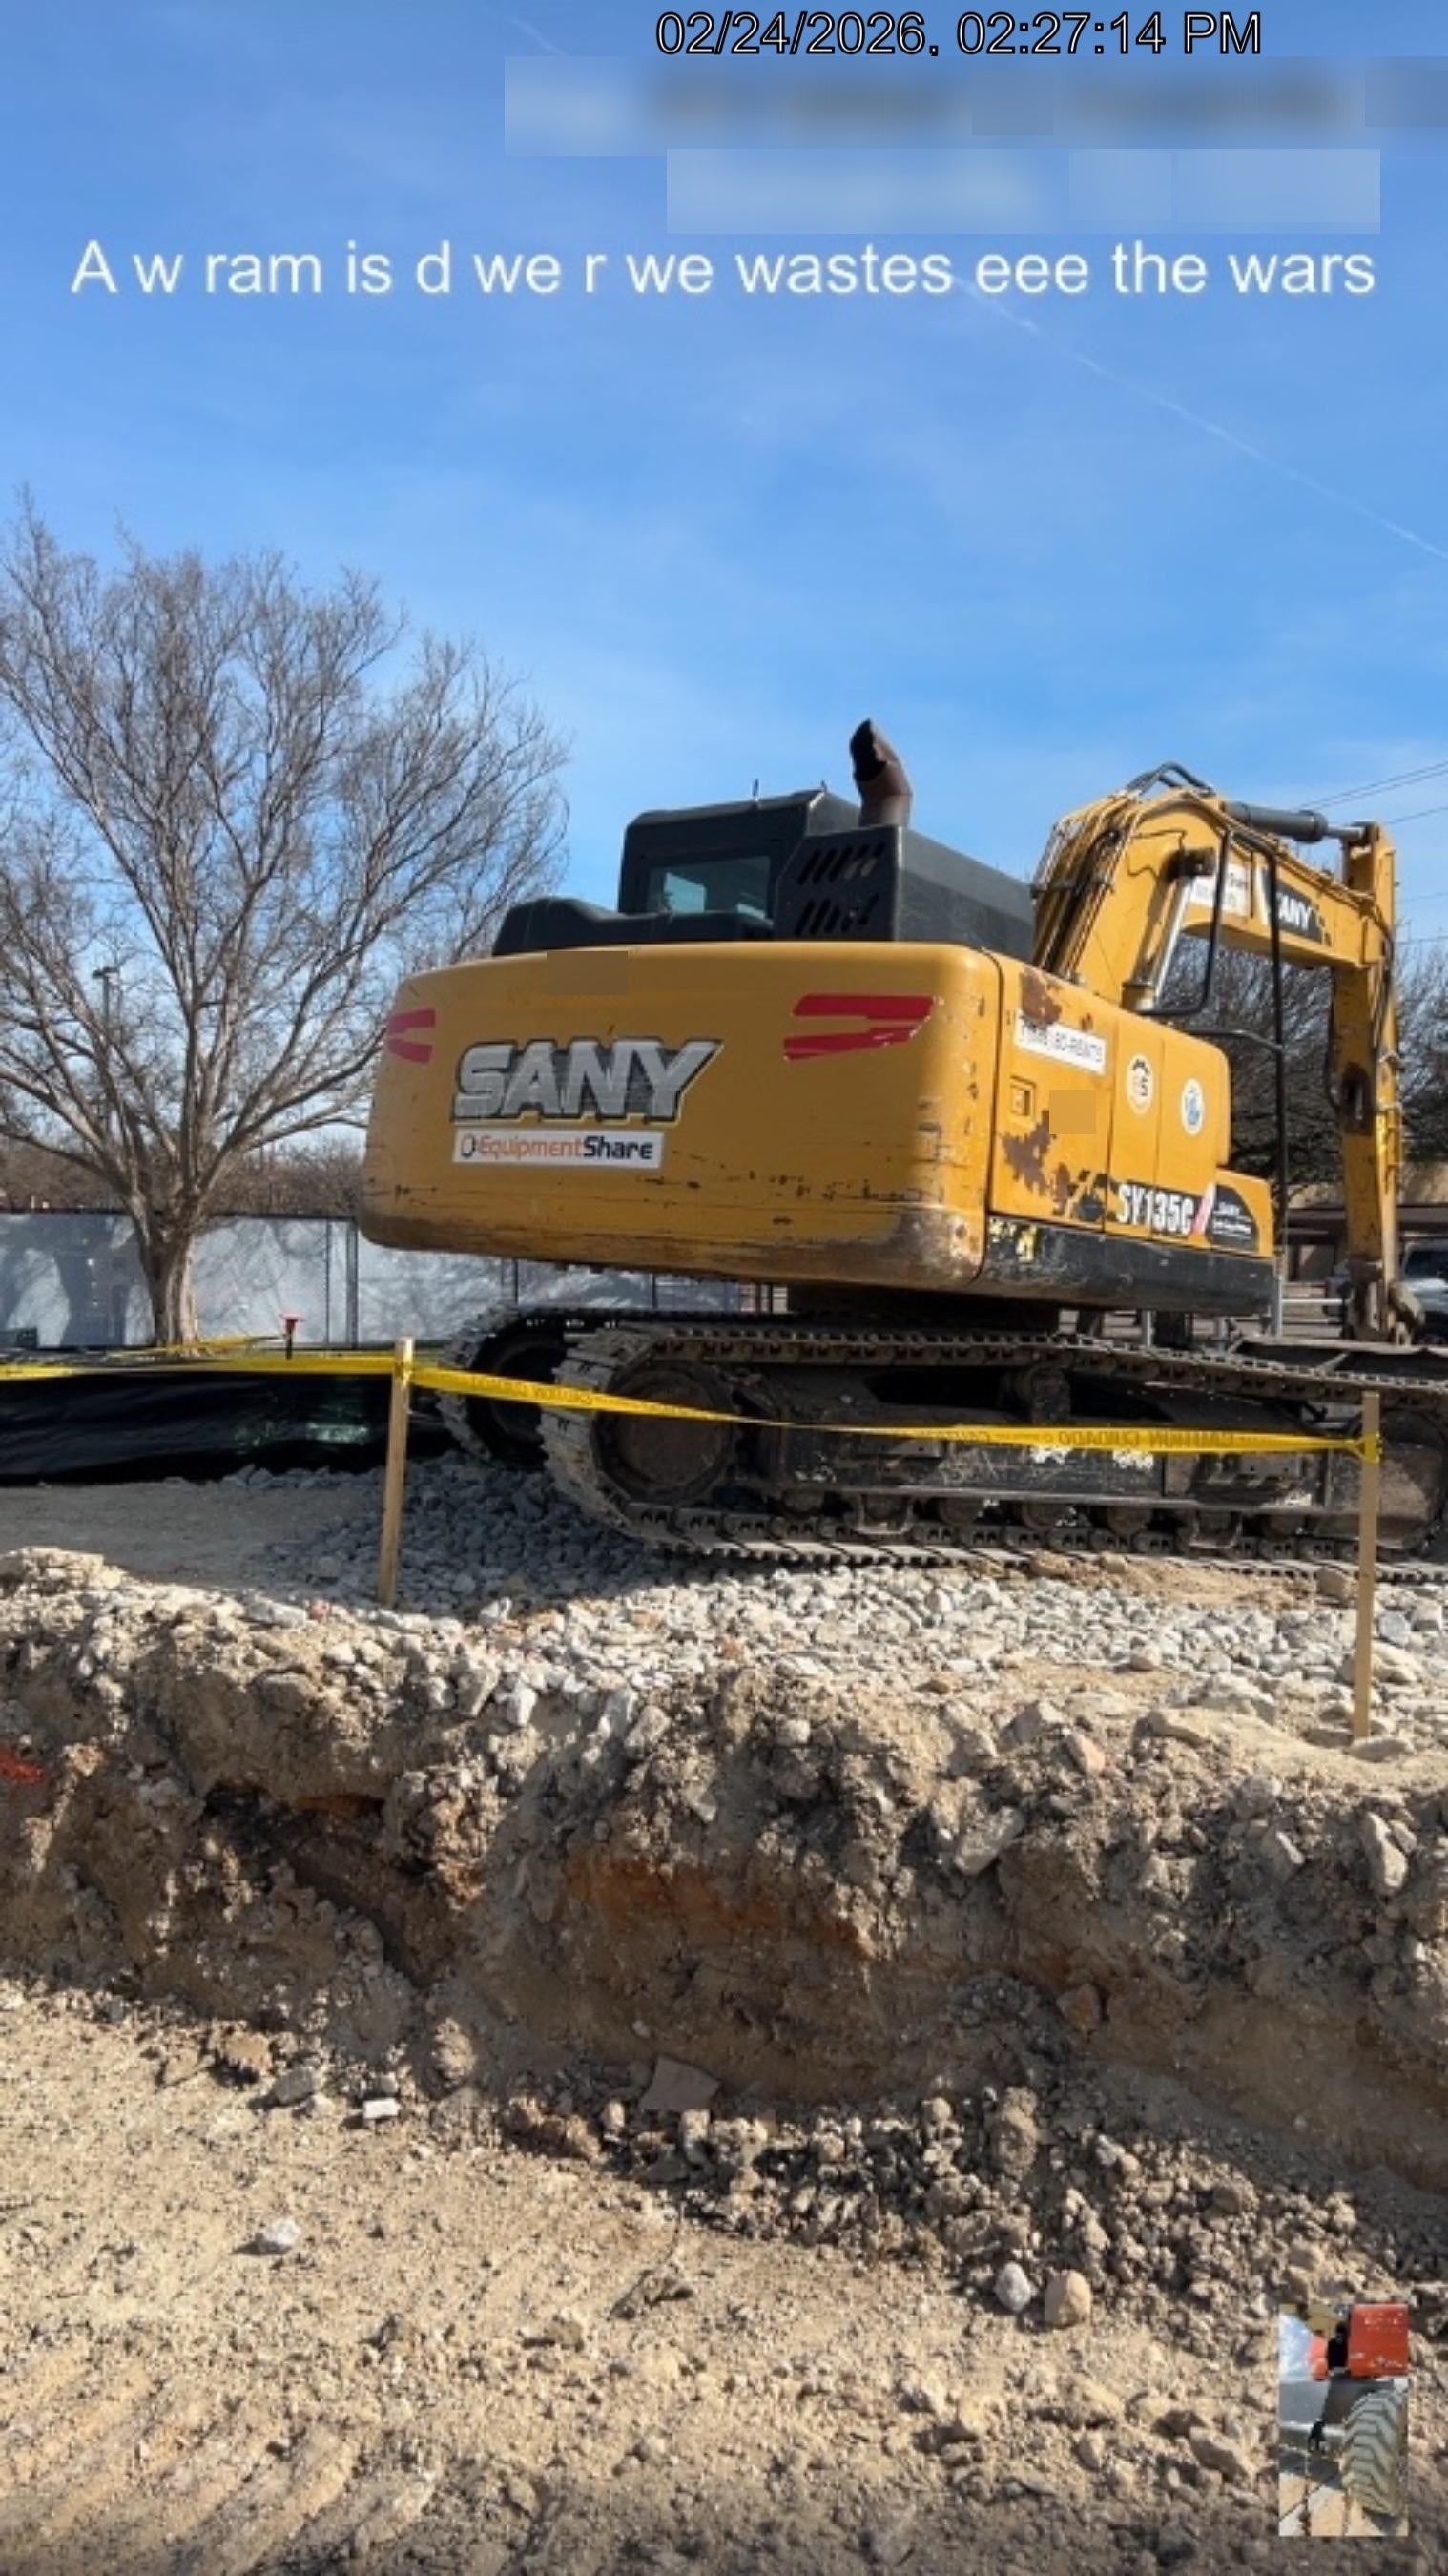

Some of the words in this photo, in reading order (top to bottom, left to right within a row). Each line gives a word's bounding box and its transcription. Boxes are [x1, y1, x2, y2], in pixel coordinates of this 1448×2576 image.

[452, 1037, 723, 1124] SANY
[480, 1133, 653, 1161] EquipmentShare
[1116, 1181, 1195, 1236] SY135C
